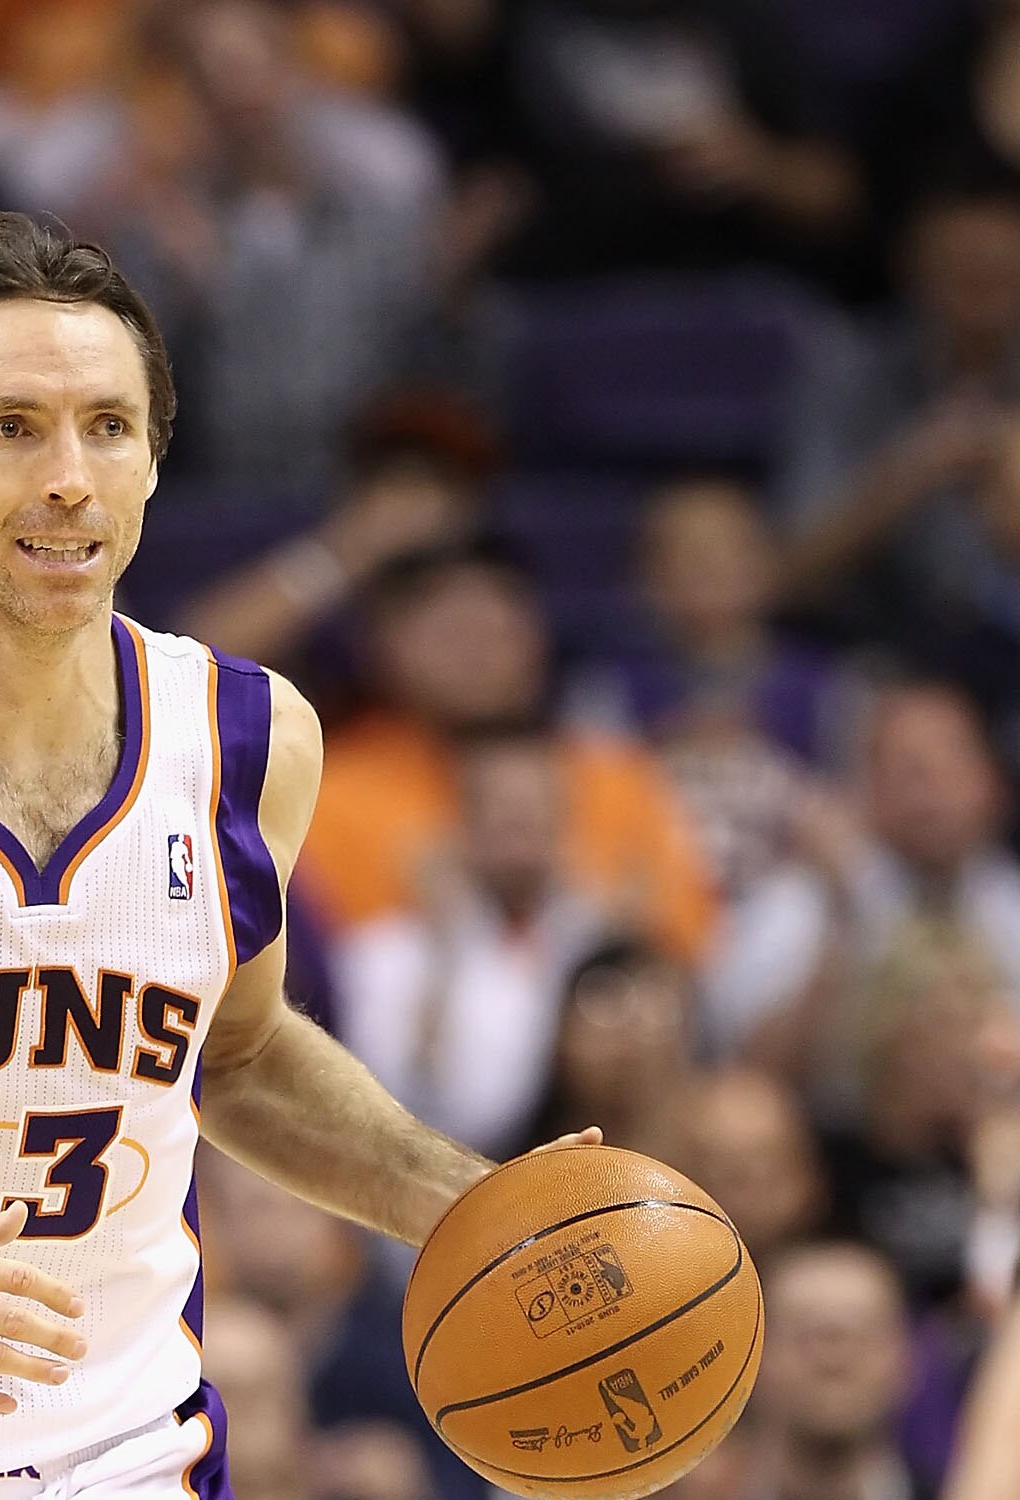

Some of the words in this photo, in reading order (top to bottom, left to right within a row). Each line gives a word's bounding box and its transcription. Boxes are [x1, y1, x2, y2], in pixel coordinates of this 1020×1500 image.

[169, 886, 187, 898] NBA
[698, 1340, 725, 1371] OFFICIAL
[610, 1373, 634, 1391] NBA
[678, 1365, 700, 1393] GAME
[657, 1386, 680, 1401] BALL
